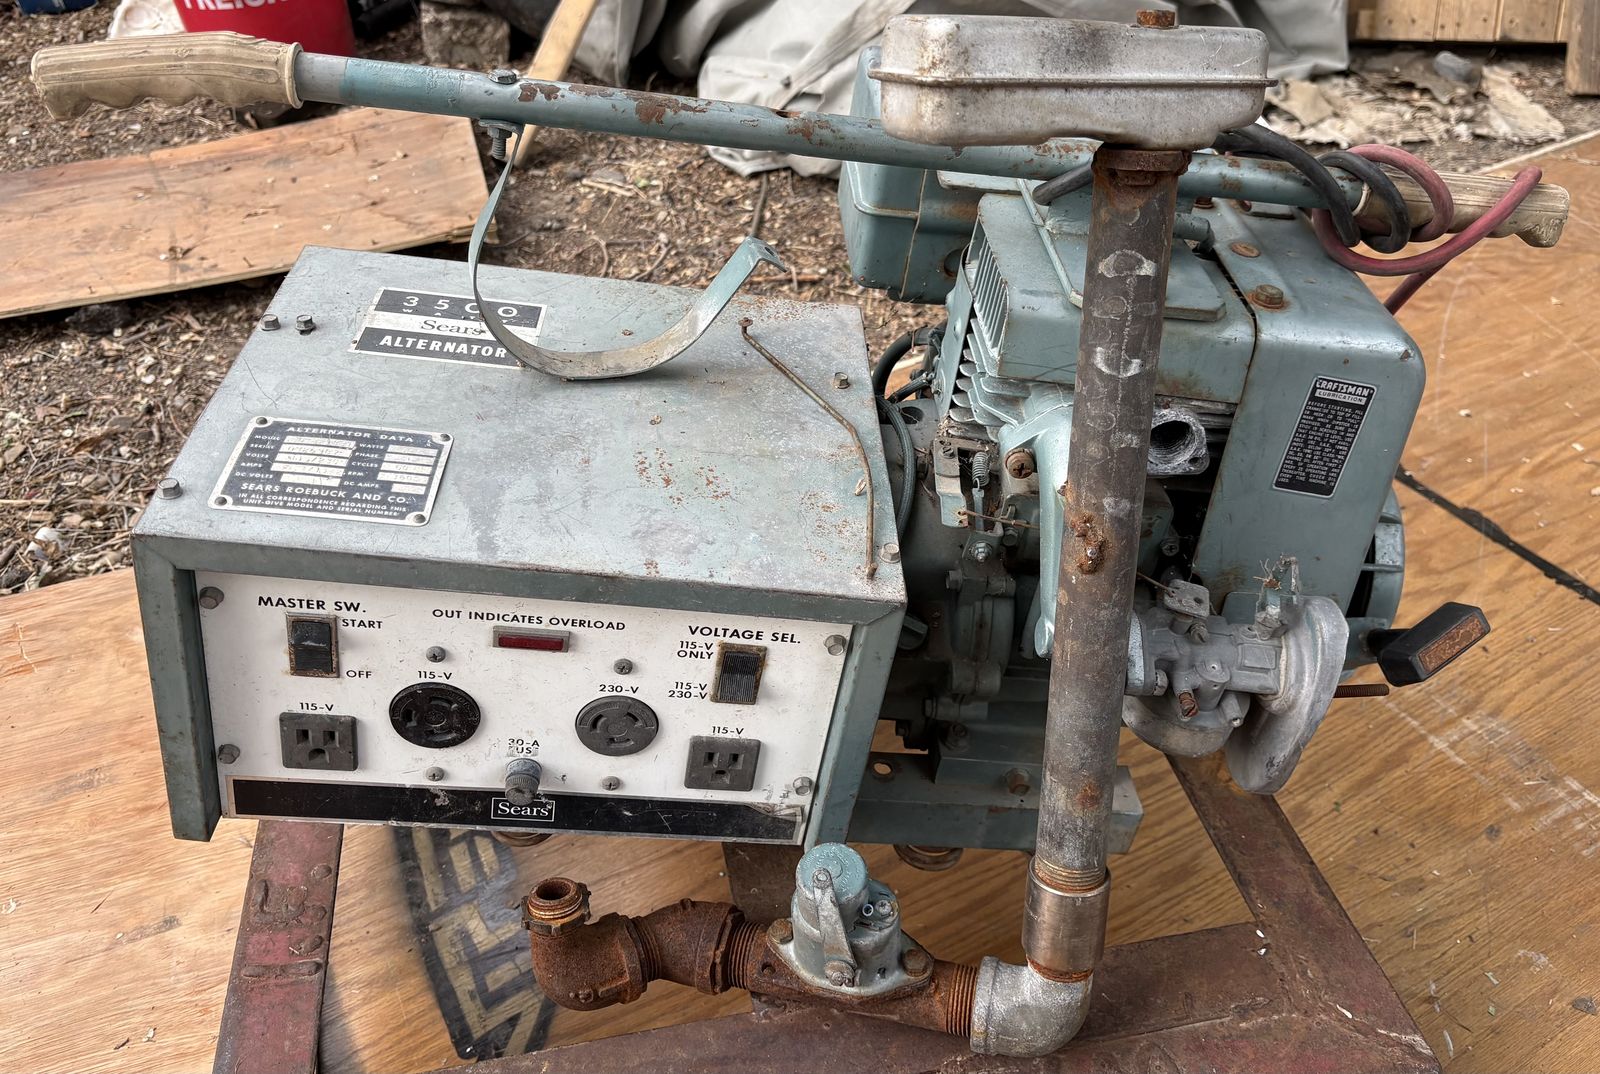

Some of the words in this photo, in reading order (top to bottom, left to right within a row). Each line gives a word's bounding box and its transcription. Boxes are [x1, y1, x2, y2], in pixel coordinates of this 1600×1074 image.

[420, 319, 485, 336] Sears
[379, 335, 508, 359] ALTERNATOR
[1318, 390, 1363, 403] LUBRICATION
[286, 427, 371, 438] ALTERNATOR
[380, 434, 413, 442] DATA
[241, 483, 280, 492] SEARS
[286, 486, 347, 498] ROEBUCK
[352, 493, 381, 501] AND
[387, 496, 409, 504] CO.
[266, 495, 338, 505] CORRESPONDENCE
[340, 501, 387, 510] REGARDING
[257, 595, 326, 610] MASTER
[334, 601, 367, 613] SW.
[342, 618, 383, 629] START
[432, 608, 462, 619] OUT
[468, 611, 543, 625] INDICATES
[549, 617, 626, 631] OVERLOAD
[688, 625, 764, 640] VOLTAGE
[770, 632, 801, 644] SEL.
[680, 640, 714, 650] 115-V
[677, 650, 714, 660] ONLY
[346, 669, 372, 679] OFF
[417, 670, 453, 681] 115-V
[599, 684, 639, 694] 230-V
[674, 681, 707, 691] 115-V
[668, 690, 707, 700] 230-V
[299, 702, 334, 712] 115-V
[712, 726, 745, 735] 115-V
[508, 738, 540, 747] 30-A
[508, 746, 540, 755] US
[497, 802, 549, 817] Sears
